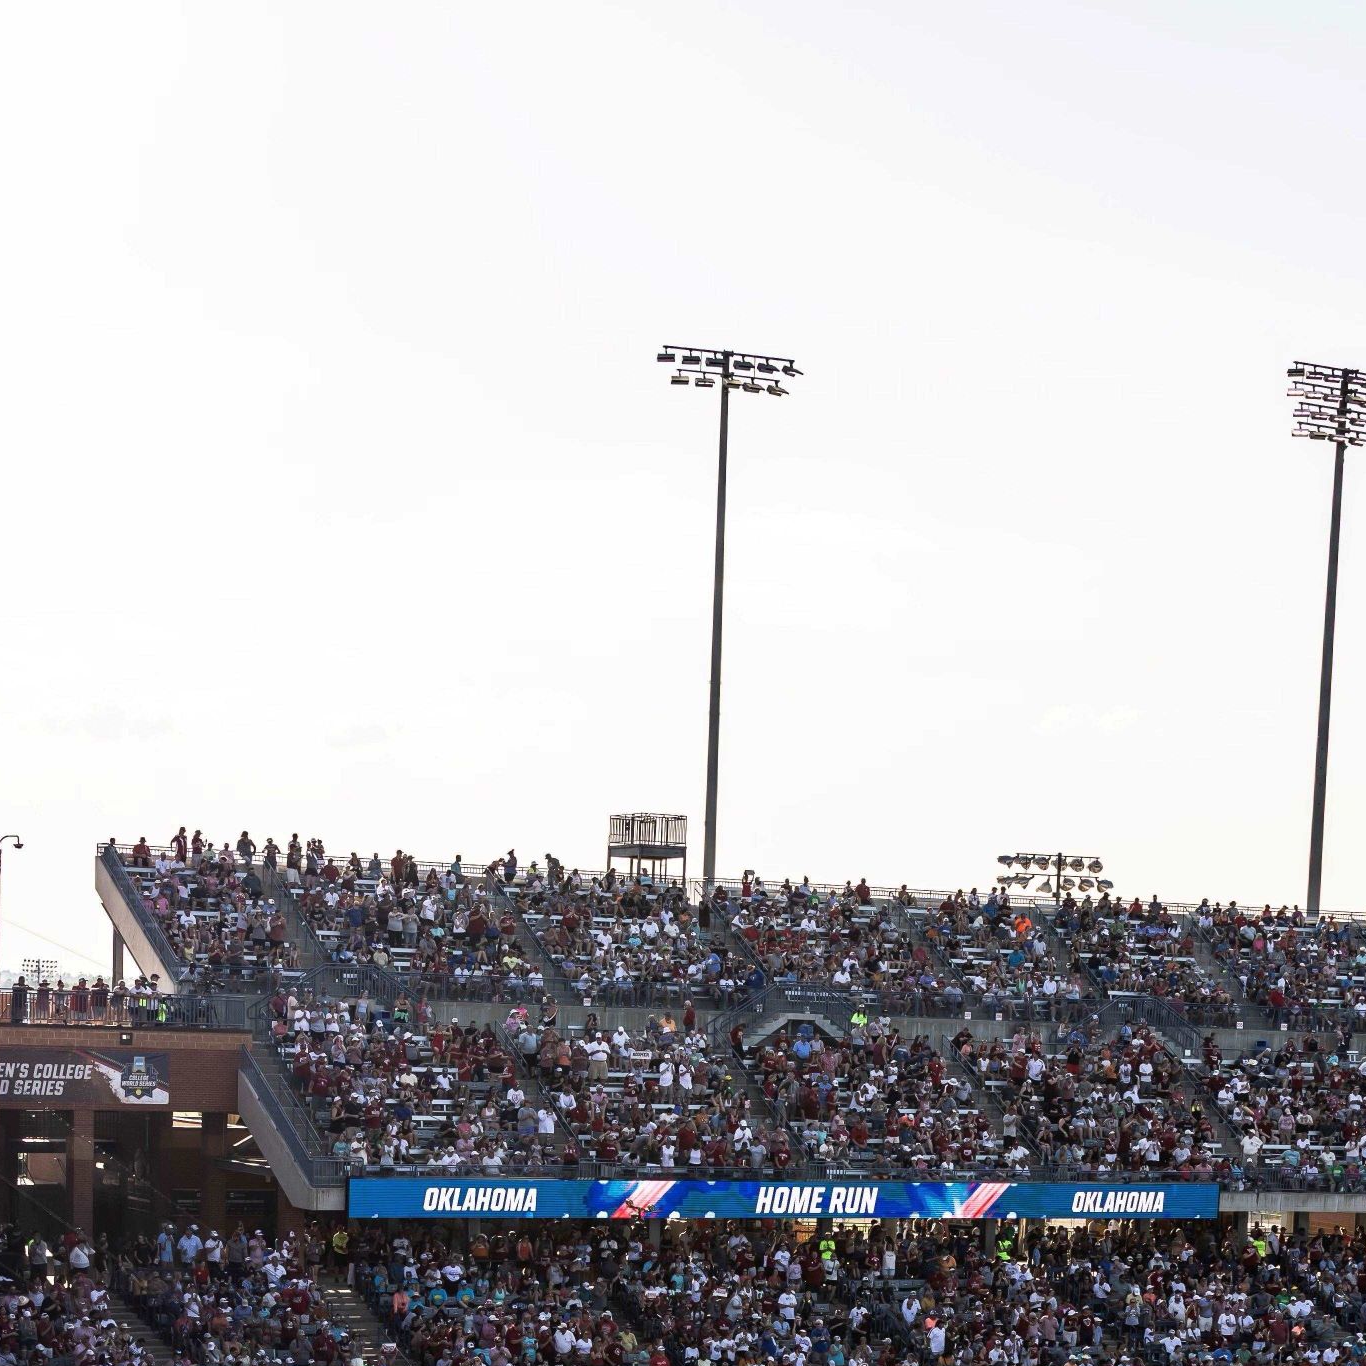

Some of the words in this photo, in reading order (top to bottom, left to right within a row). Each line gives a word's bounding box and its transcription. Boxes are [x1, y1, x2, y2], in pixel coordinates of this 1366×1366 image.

[34, 1063, 93, 1080] COLLEGE
[14, 1080, 65, 1096] SERIES
[423, 1187, 537, 1211] OKLAHOMA
[755, 1187, 825, 1214] HOME
[828, 1187, 878, 1214] RUN
[1072, 1191, 1165, 1212] OKLAHOMA
